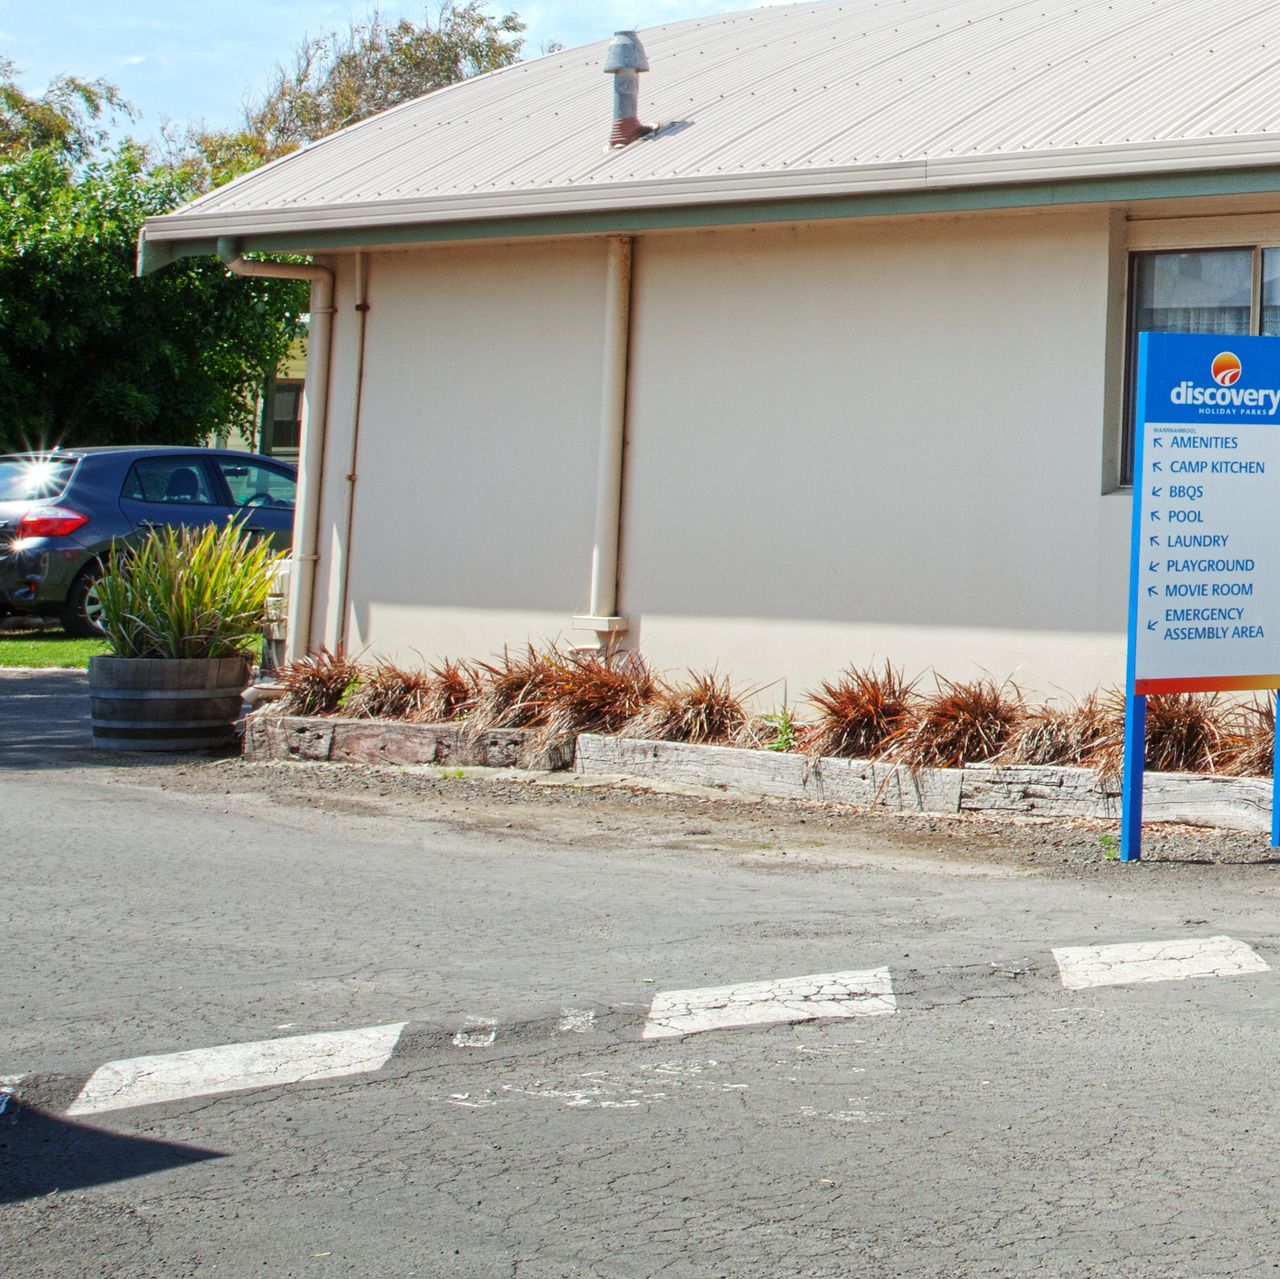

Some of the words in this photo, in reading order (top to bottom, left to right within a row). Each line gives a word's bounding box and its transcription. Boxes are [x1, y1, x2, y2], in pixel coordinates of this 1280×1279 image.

[1170, 436, 1238, 449] AMENITIES
[1170, 460, 1208, 473] CAMP
[1211, 461, 1265, 474] KITCHEN
[1169, 485, 1204, 500] BBQS
[1168, 510, 1204, 523] POOL
[1167, 535, 1229, 548] LAUNDRY
[1166, 559, 1255, 572] PLAYGROUND
[1165, 584, 1209, 597] MOVIE
[1212, 583, 1254, 596] ROOM
[1165, 607, 1244, 621] EMERGENCY
[1164, 626, 1229, 640] ASSEMBLY
[1231, 625, 1265, 638] AREA
